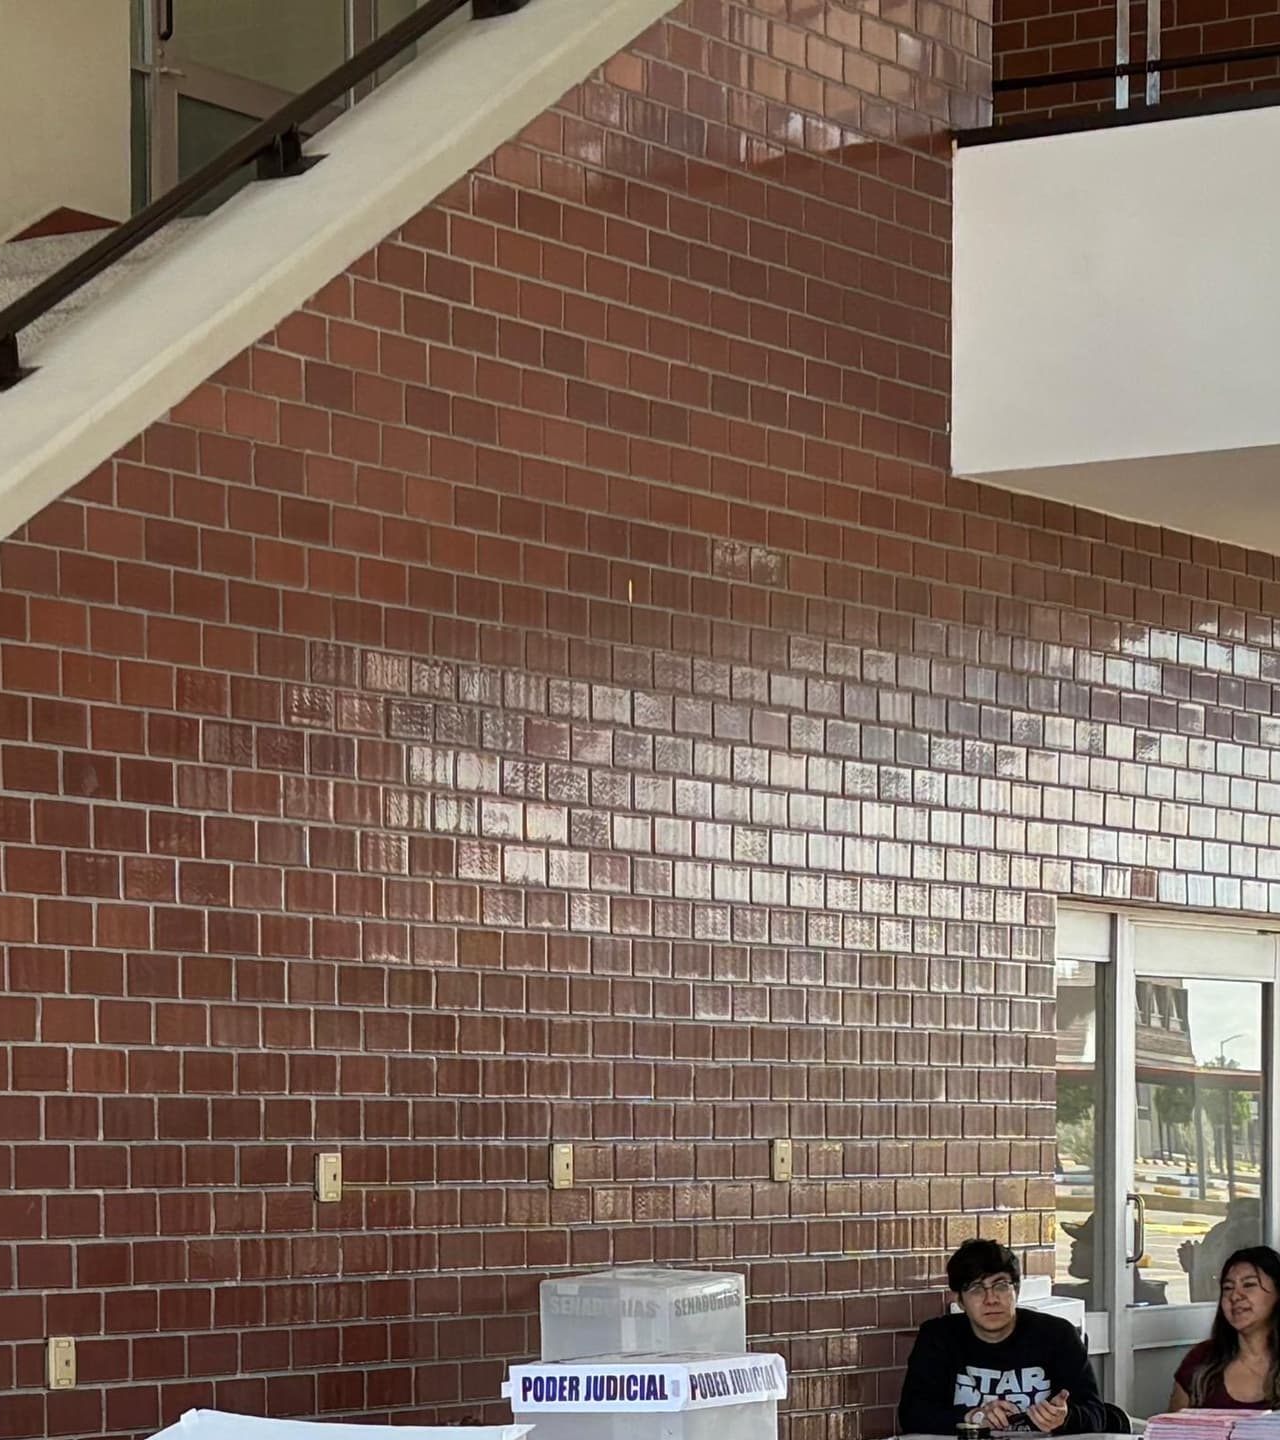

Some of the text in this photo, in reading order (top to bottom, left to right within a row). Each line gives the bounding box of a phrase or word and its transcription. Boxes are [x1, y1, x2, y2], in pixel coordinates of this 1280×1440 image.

[521, 1375, 668, 1401] PODER JUDICIAL
[689, 1364, 778, 1400] PODER JUDICIAL
[956, 1365, 1051, 1394] STAR
